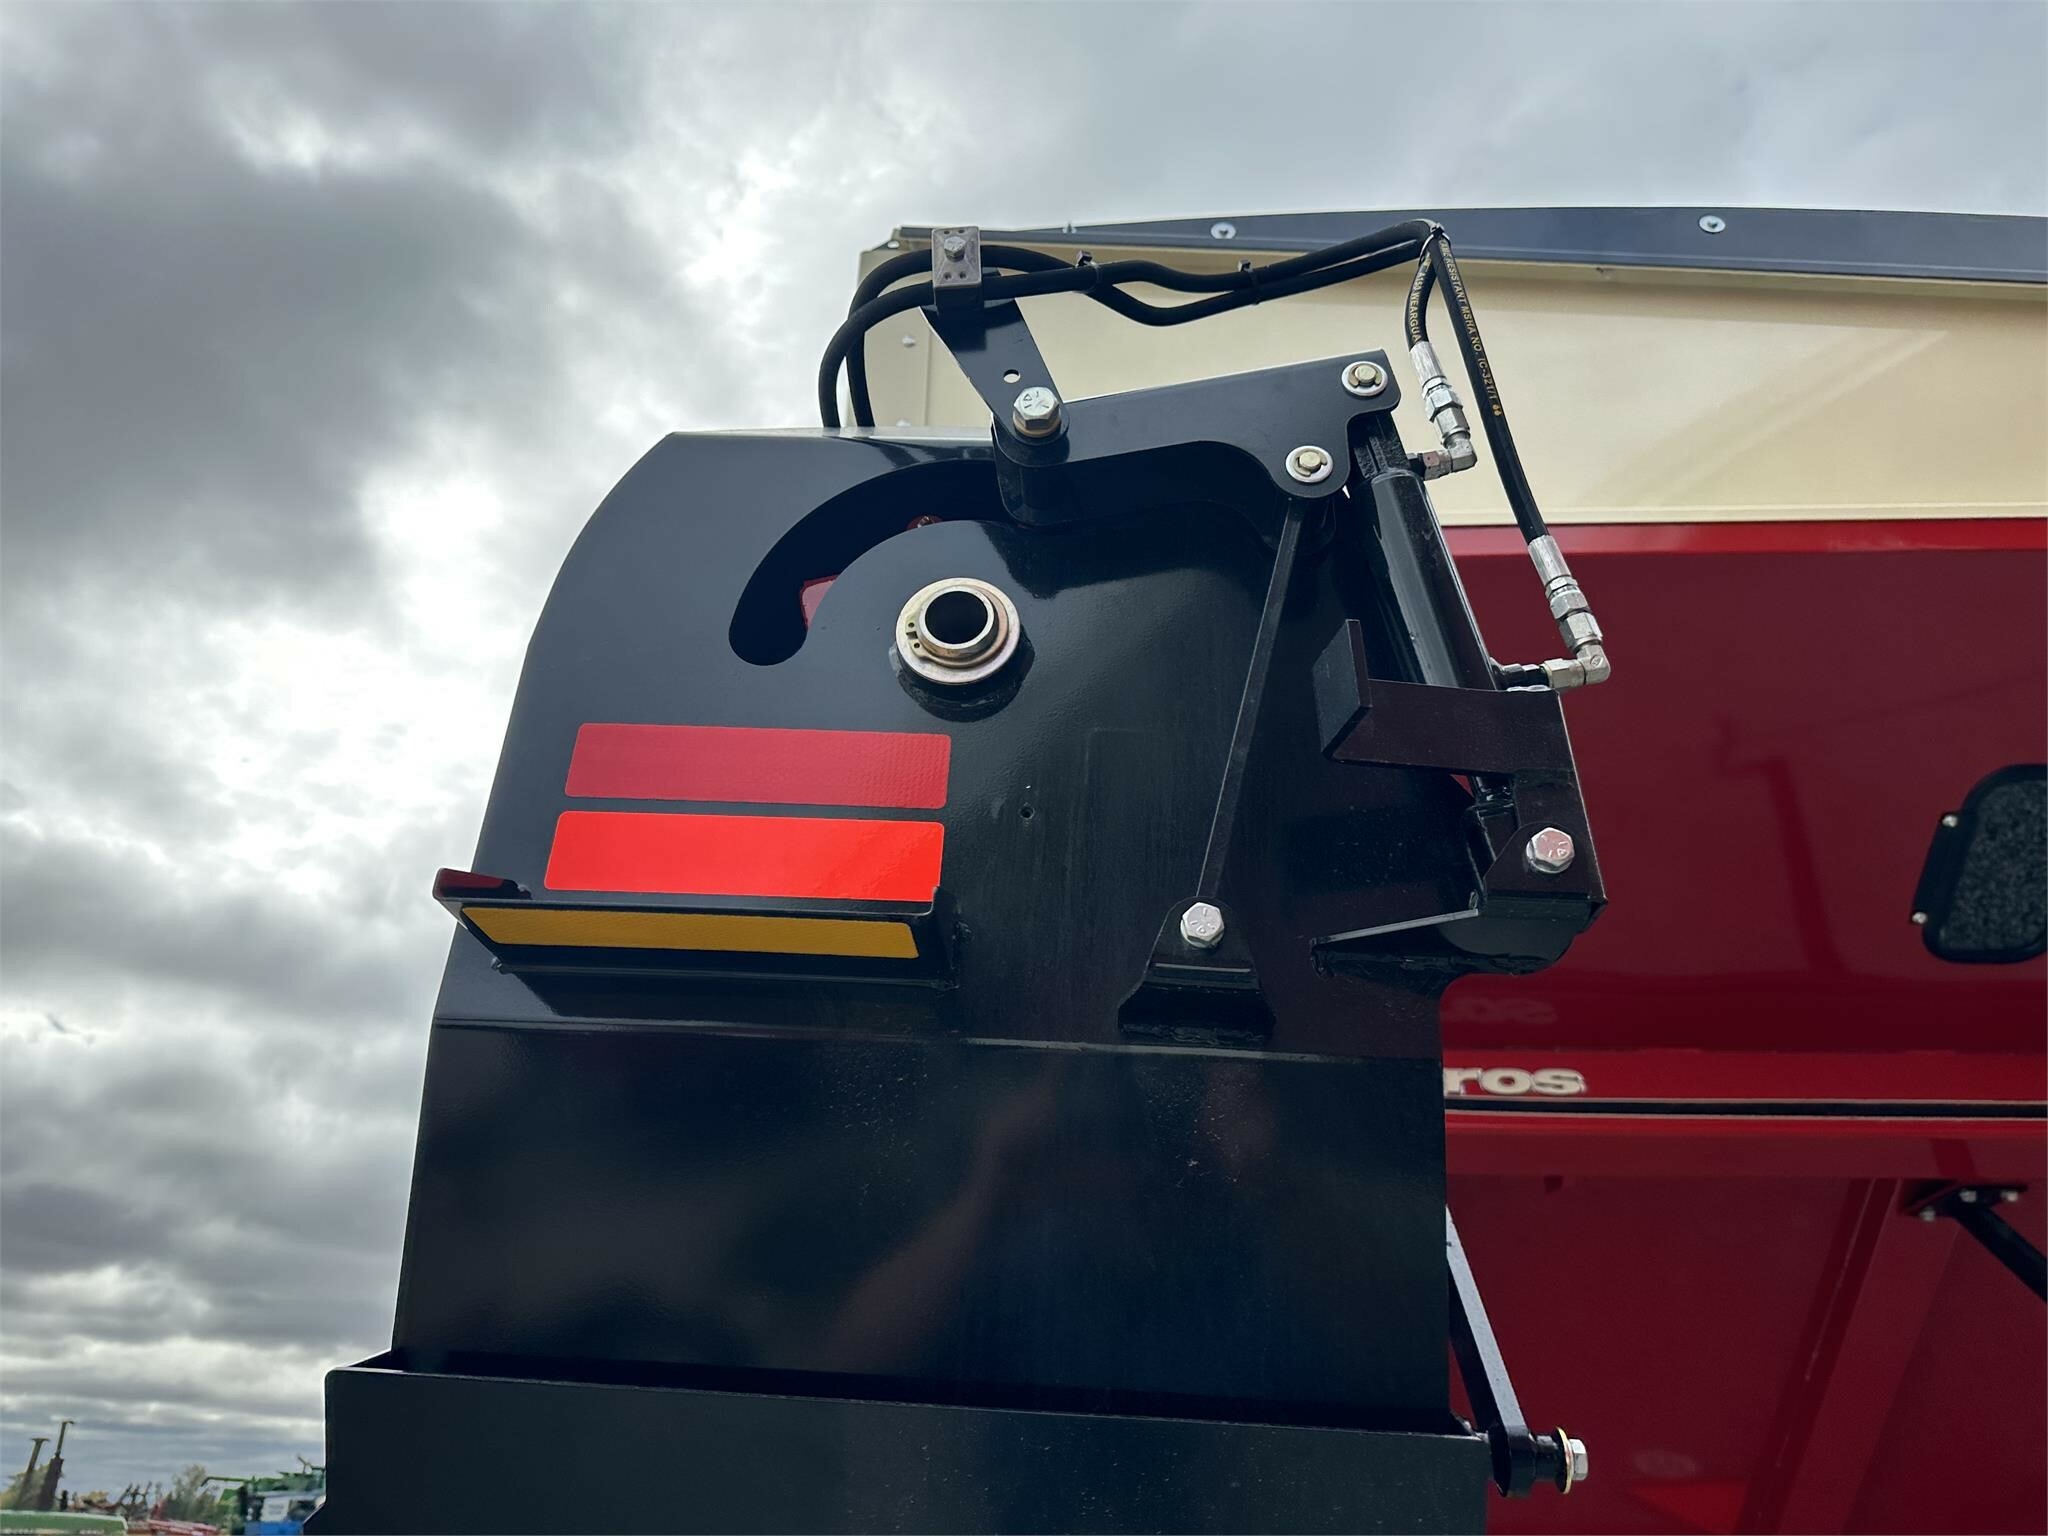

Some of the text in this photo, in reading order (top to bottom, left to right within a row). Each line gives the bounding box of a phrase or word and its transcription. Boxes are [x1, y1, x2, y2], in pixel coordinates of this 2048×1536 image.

[1445, 258, 1468, 305] RESISTANT
[1461, 305, 1477, 335] MSHA
[1443, 1067, 1585, 1096] ros
